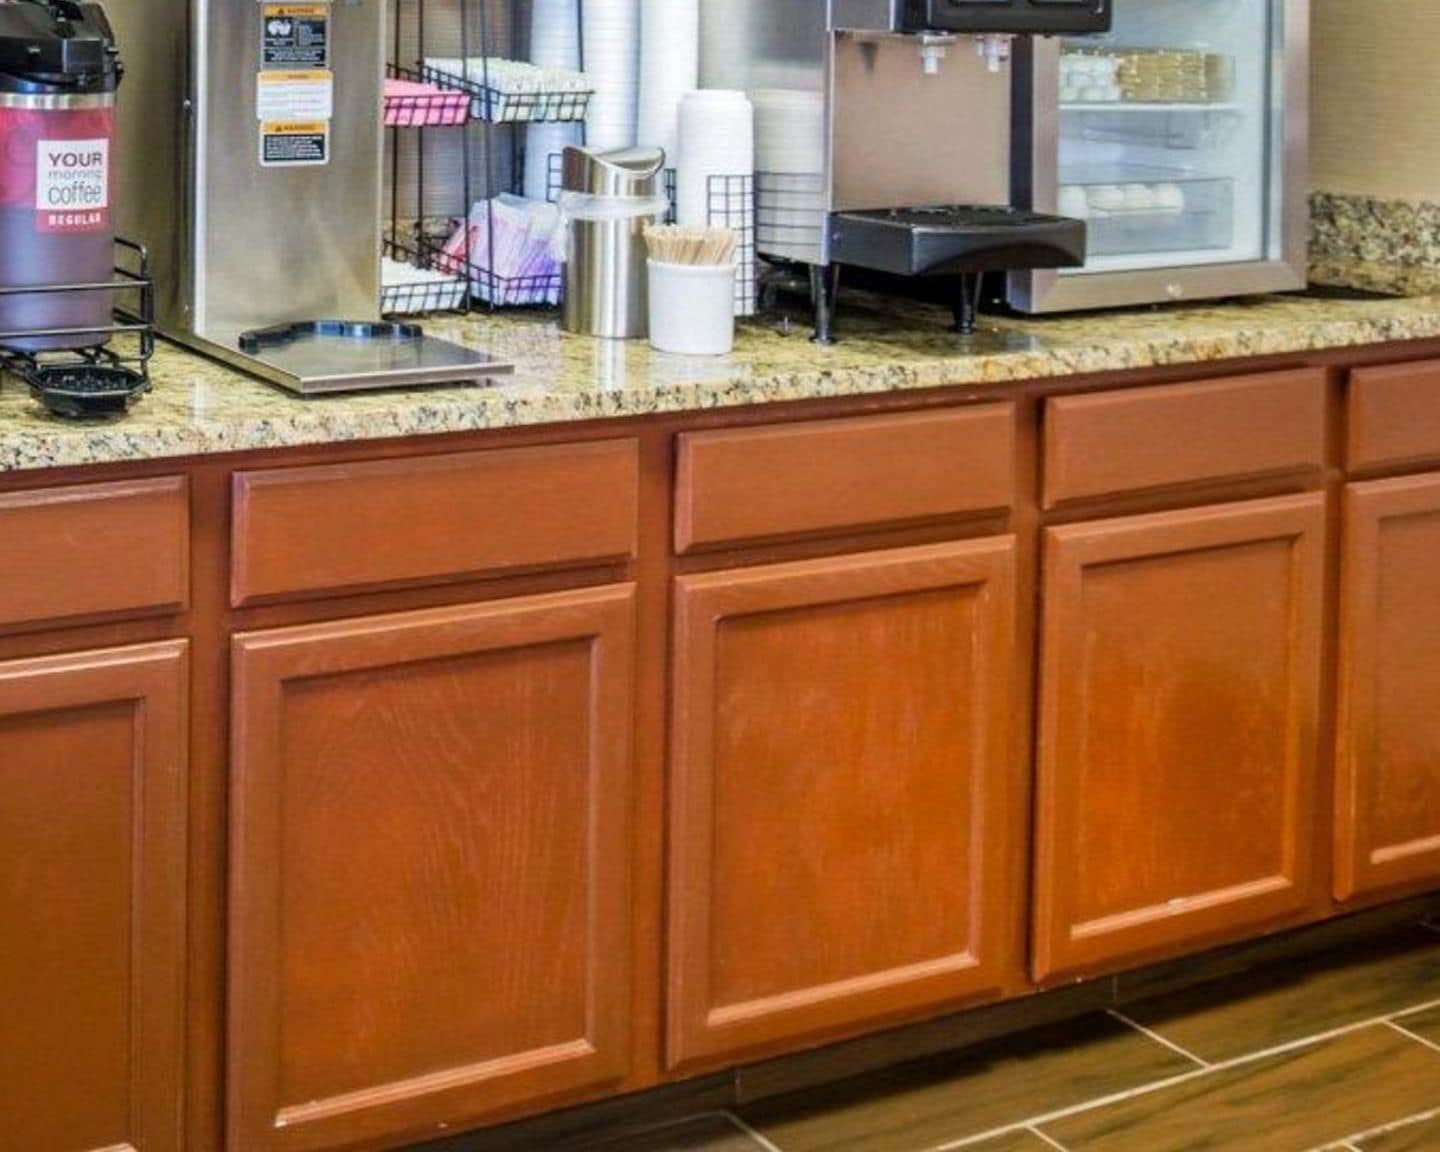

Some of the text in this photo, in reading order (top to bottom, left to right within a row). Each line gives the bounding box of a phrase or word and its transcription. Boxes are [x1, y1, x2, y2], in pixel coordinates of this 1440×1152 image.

[48, 152, 102, 167] YOUR
[48, 169, 102, 180] morning
[48, 181, 101, 204] coffee
[48, 213, 101, 225] REGULAR
